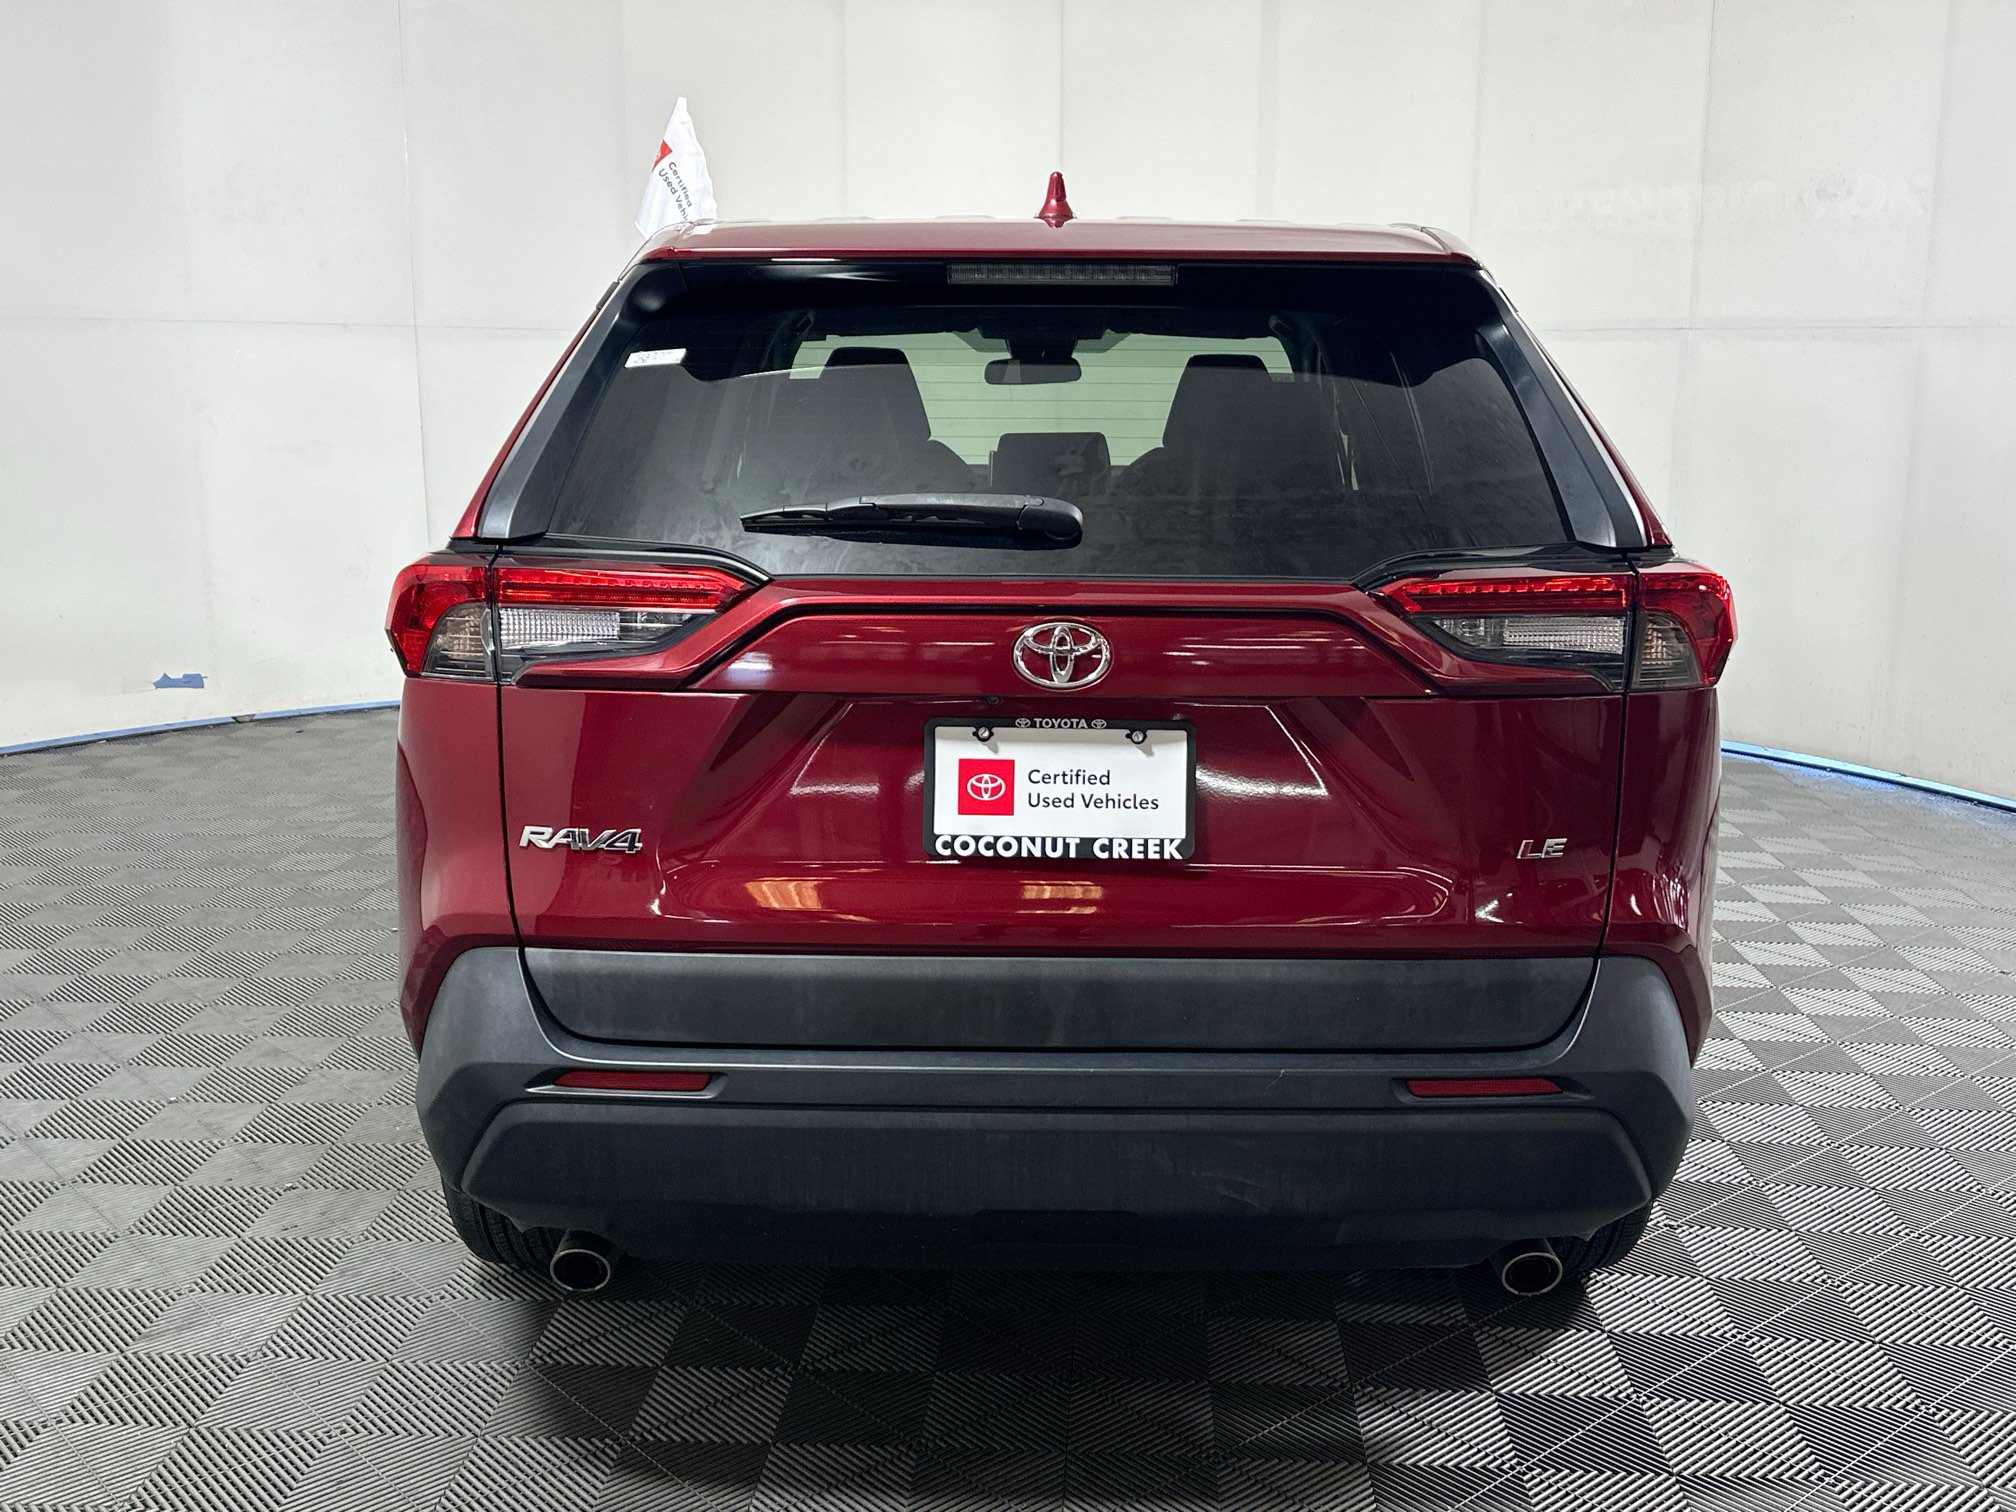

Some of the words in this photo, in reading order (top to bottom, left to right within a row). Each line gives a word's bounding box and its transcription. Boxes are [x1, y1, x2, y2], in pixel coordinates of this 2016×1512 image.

[659, 168, 679, 195] Used
[669, 162, 693, 207] Certified
[1033, 718, 1088, 729] TOYOTA
[1027, 769, 1111, 786] Certified
[1027, 792, 1075, 809] Used
[1081, 793, 1159, 810] Vehicles
[519, 825, 643, 854] RAV4
[934, 835, 1080, 858] COCONUT
[1092, 838, 1184, 860] CREEK
[1516, 838, 1568, 859] LE
